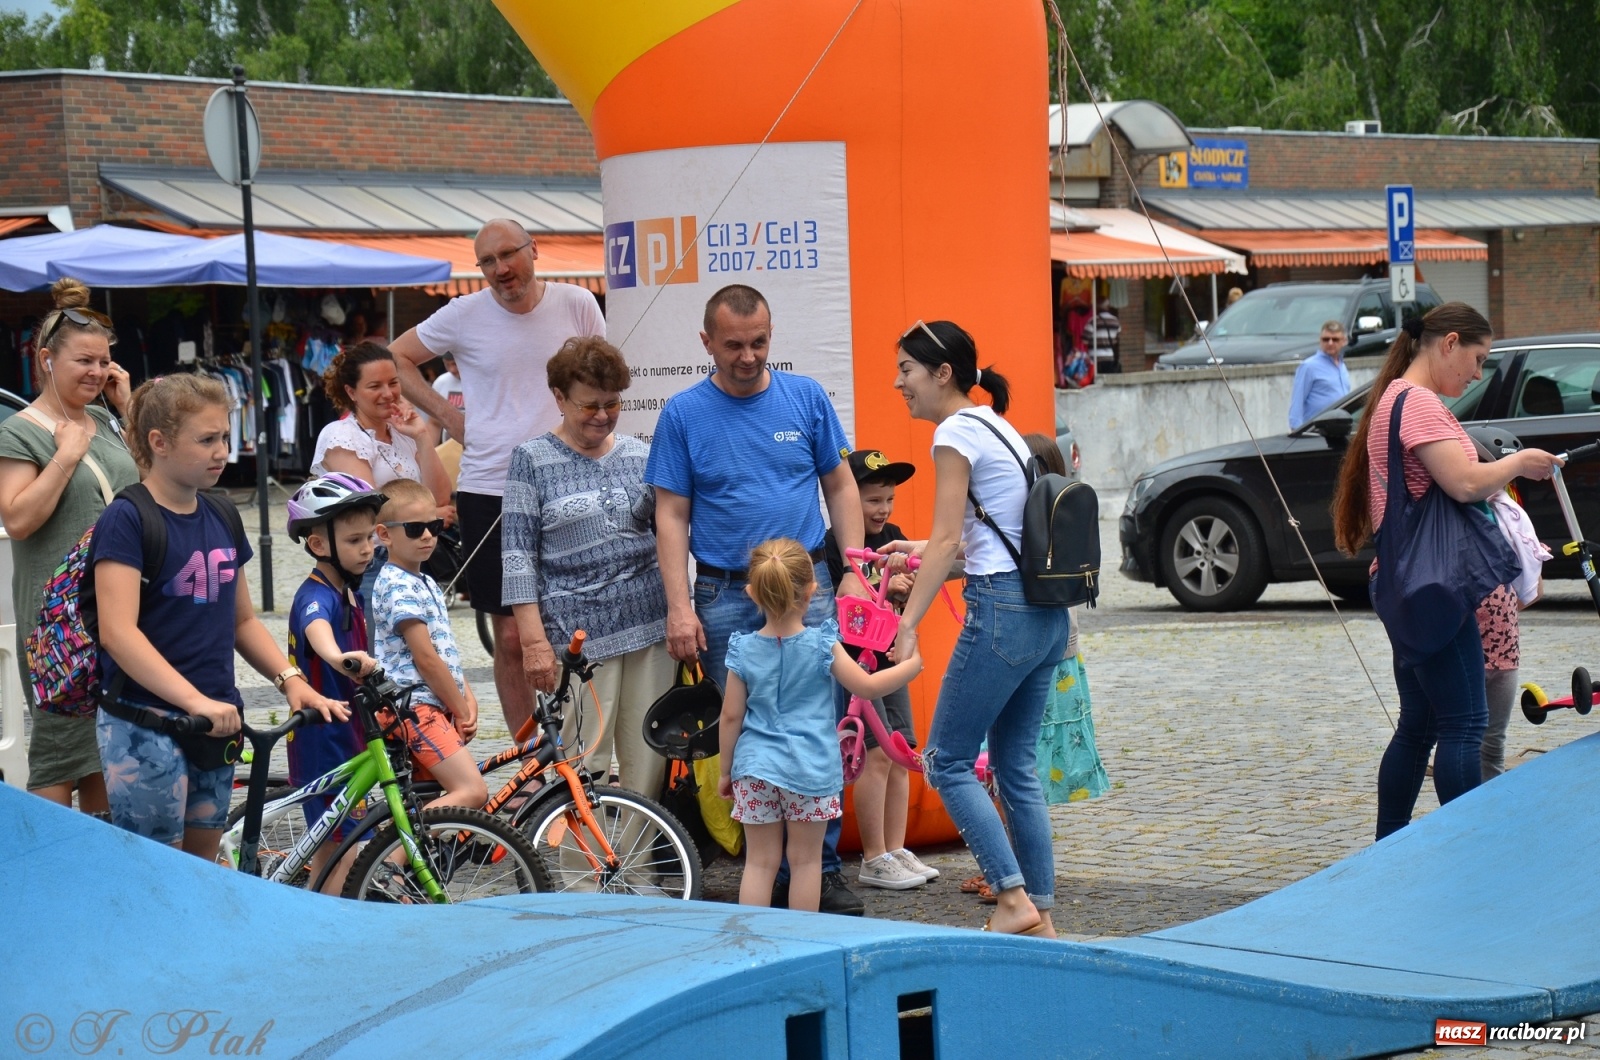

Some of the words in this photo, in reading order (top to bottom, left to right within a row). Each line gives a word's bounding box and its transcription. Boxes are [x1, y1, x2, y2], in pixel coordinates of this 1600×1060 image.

[1393, 192, 1409, 241] P
[642, 367, 648, 377] o
[650, 365, 693, 376] numerze
[162, 547, 237, 604] 4F
[271, 786, 349, 883] ACCENT
